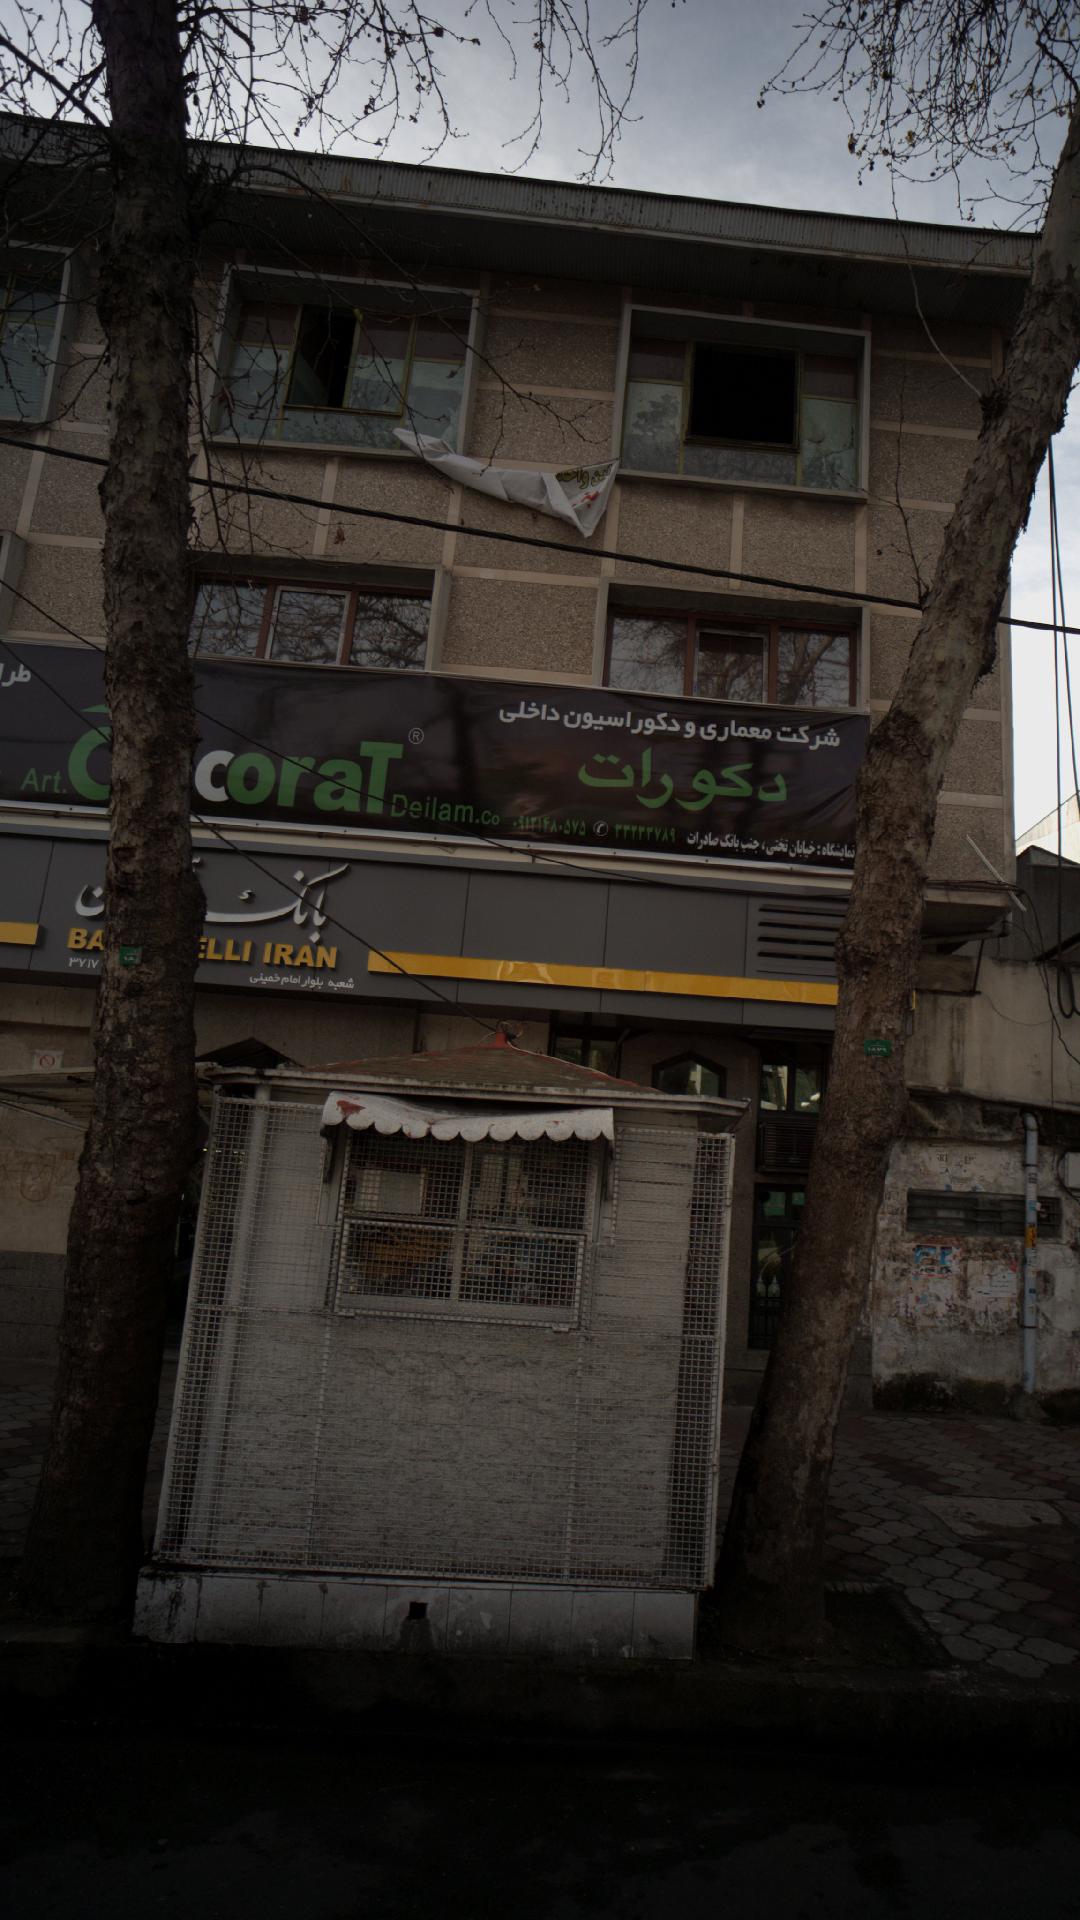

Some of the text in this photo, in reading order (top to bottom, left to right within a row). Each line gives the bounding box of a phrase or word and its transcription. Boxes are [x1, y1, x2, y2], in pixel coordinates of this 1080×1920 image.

[499, 701, 840, 750] شرکت معماری و دکوراسیون داخلی
[20, 767, 67, 794] Art.
[577, 746, 788, 812] دکورات
[686, 831, 719, 850] صادرات
[720, 834, 740, 852] بانک
[67, 927, 338, 969] BA ELLI IRAN
[248, 972, 355, 991] شعبه بلوار امام خمینی
